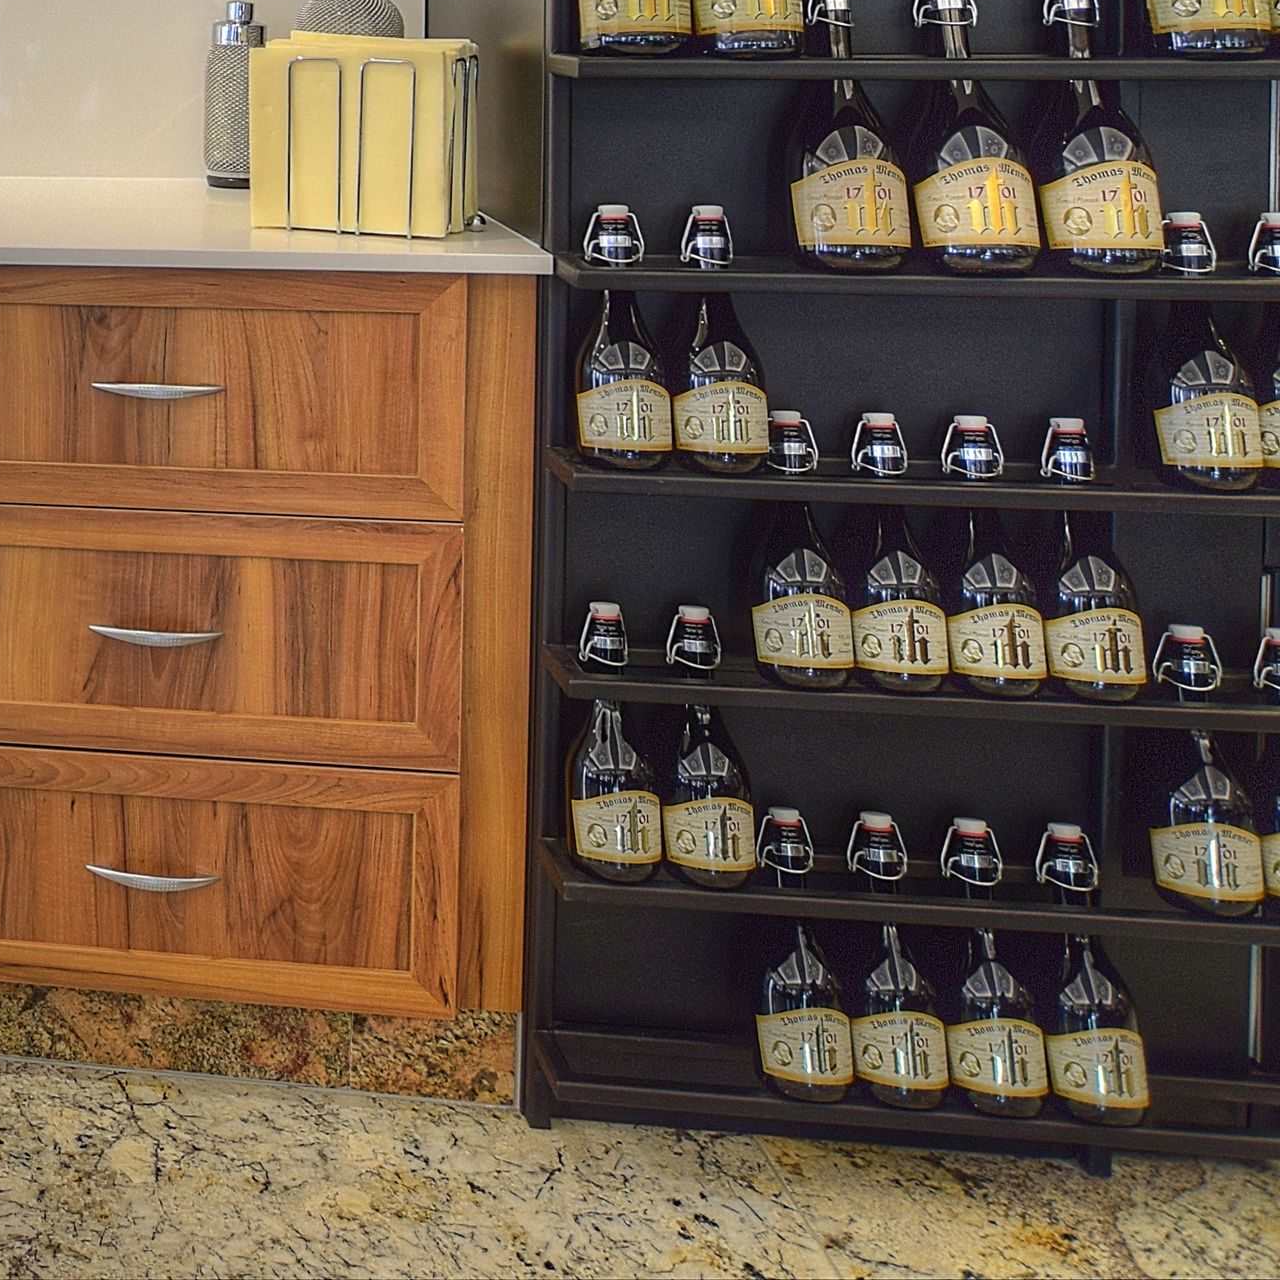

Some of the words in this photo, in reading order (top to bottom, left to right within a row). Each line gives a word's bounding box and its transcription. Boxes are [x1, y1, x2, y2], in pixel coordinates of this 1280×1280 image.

[820, 166, 868, 184] Thomas
[940, 165, 990, 185] Thomas
[1072, 168, 1123, 188] Thomas
[600, 385, 634, 399] Thomas
[694, 386, 729, 401] Thomas
[772, 599, 808, 613] Thomas
[870, 606, 908, 619] Thomas
[970, 610, 1009, 624] Thomas
[685, 803, 721, 816] Thomas
[782, 1014, 818, 1026] Thomas
